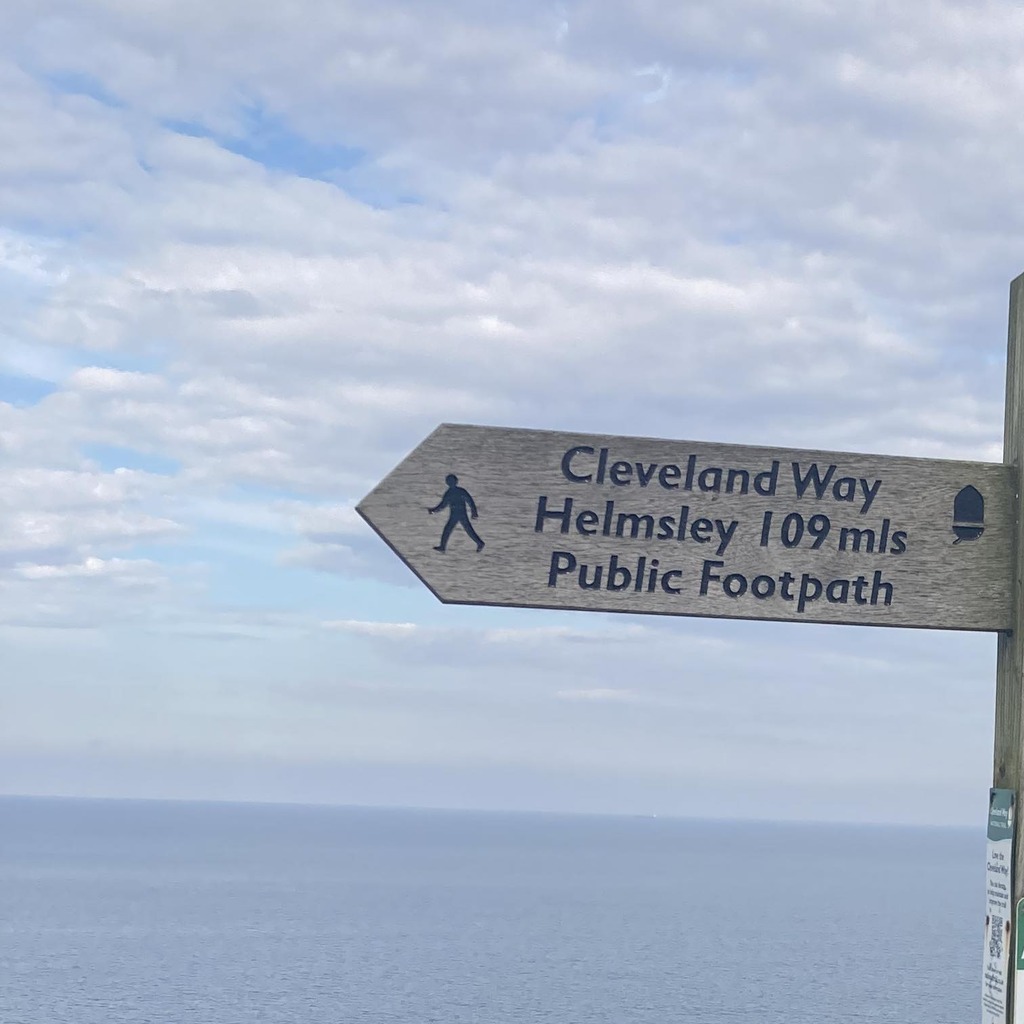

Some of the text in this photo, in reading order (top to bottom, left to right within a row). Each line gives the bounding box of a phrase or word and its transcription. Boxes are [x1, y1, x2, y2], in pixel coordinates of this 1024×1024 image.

[561, 446, 882, 515] Cleveland Way
[534, 496, 908, 556] Helmsley 109 mls
[547, 551, 894, 613] Public Footpath
